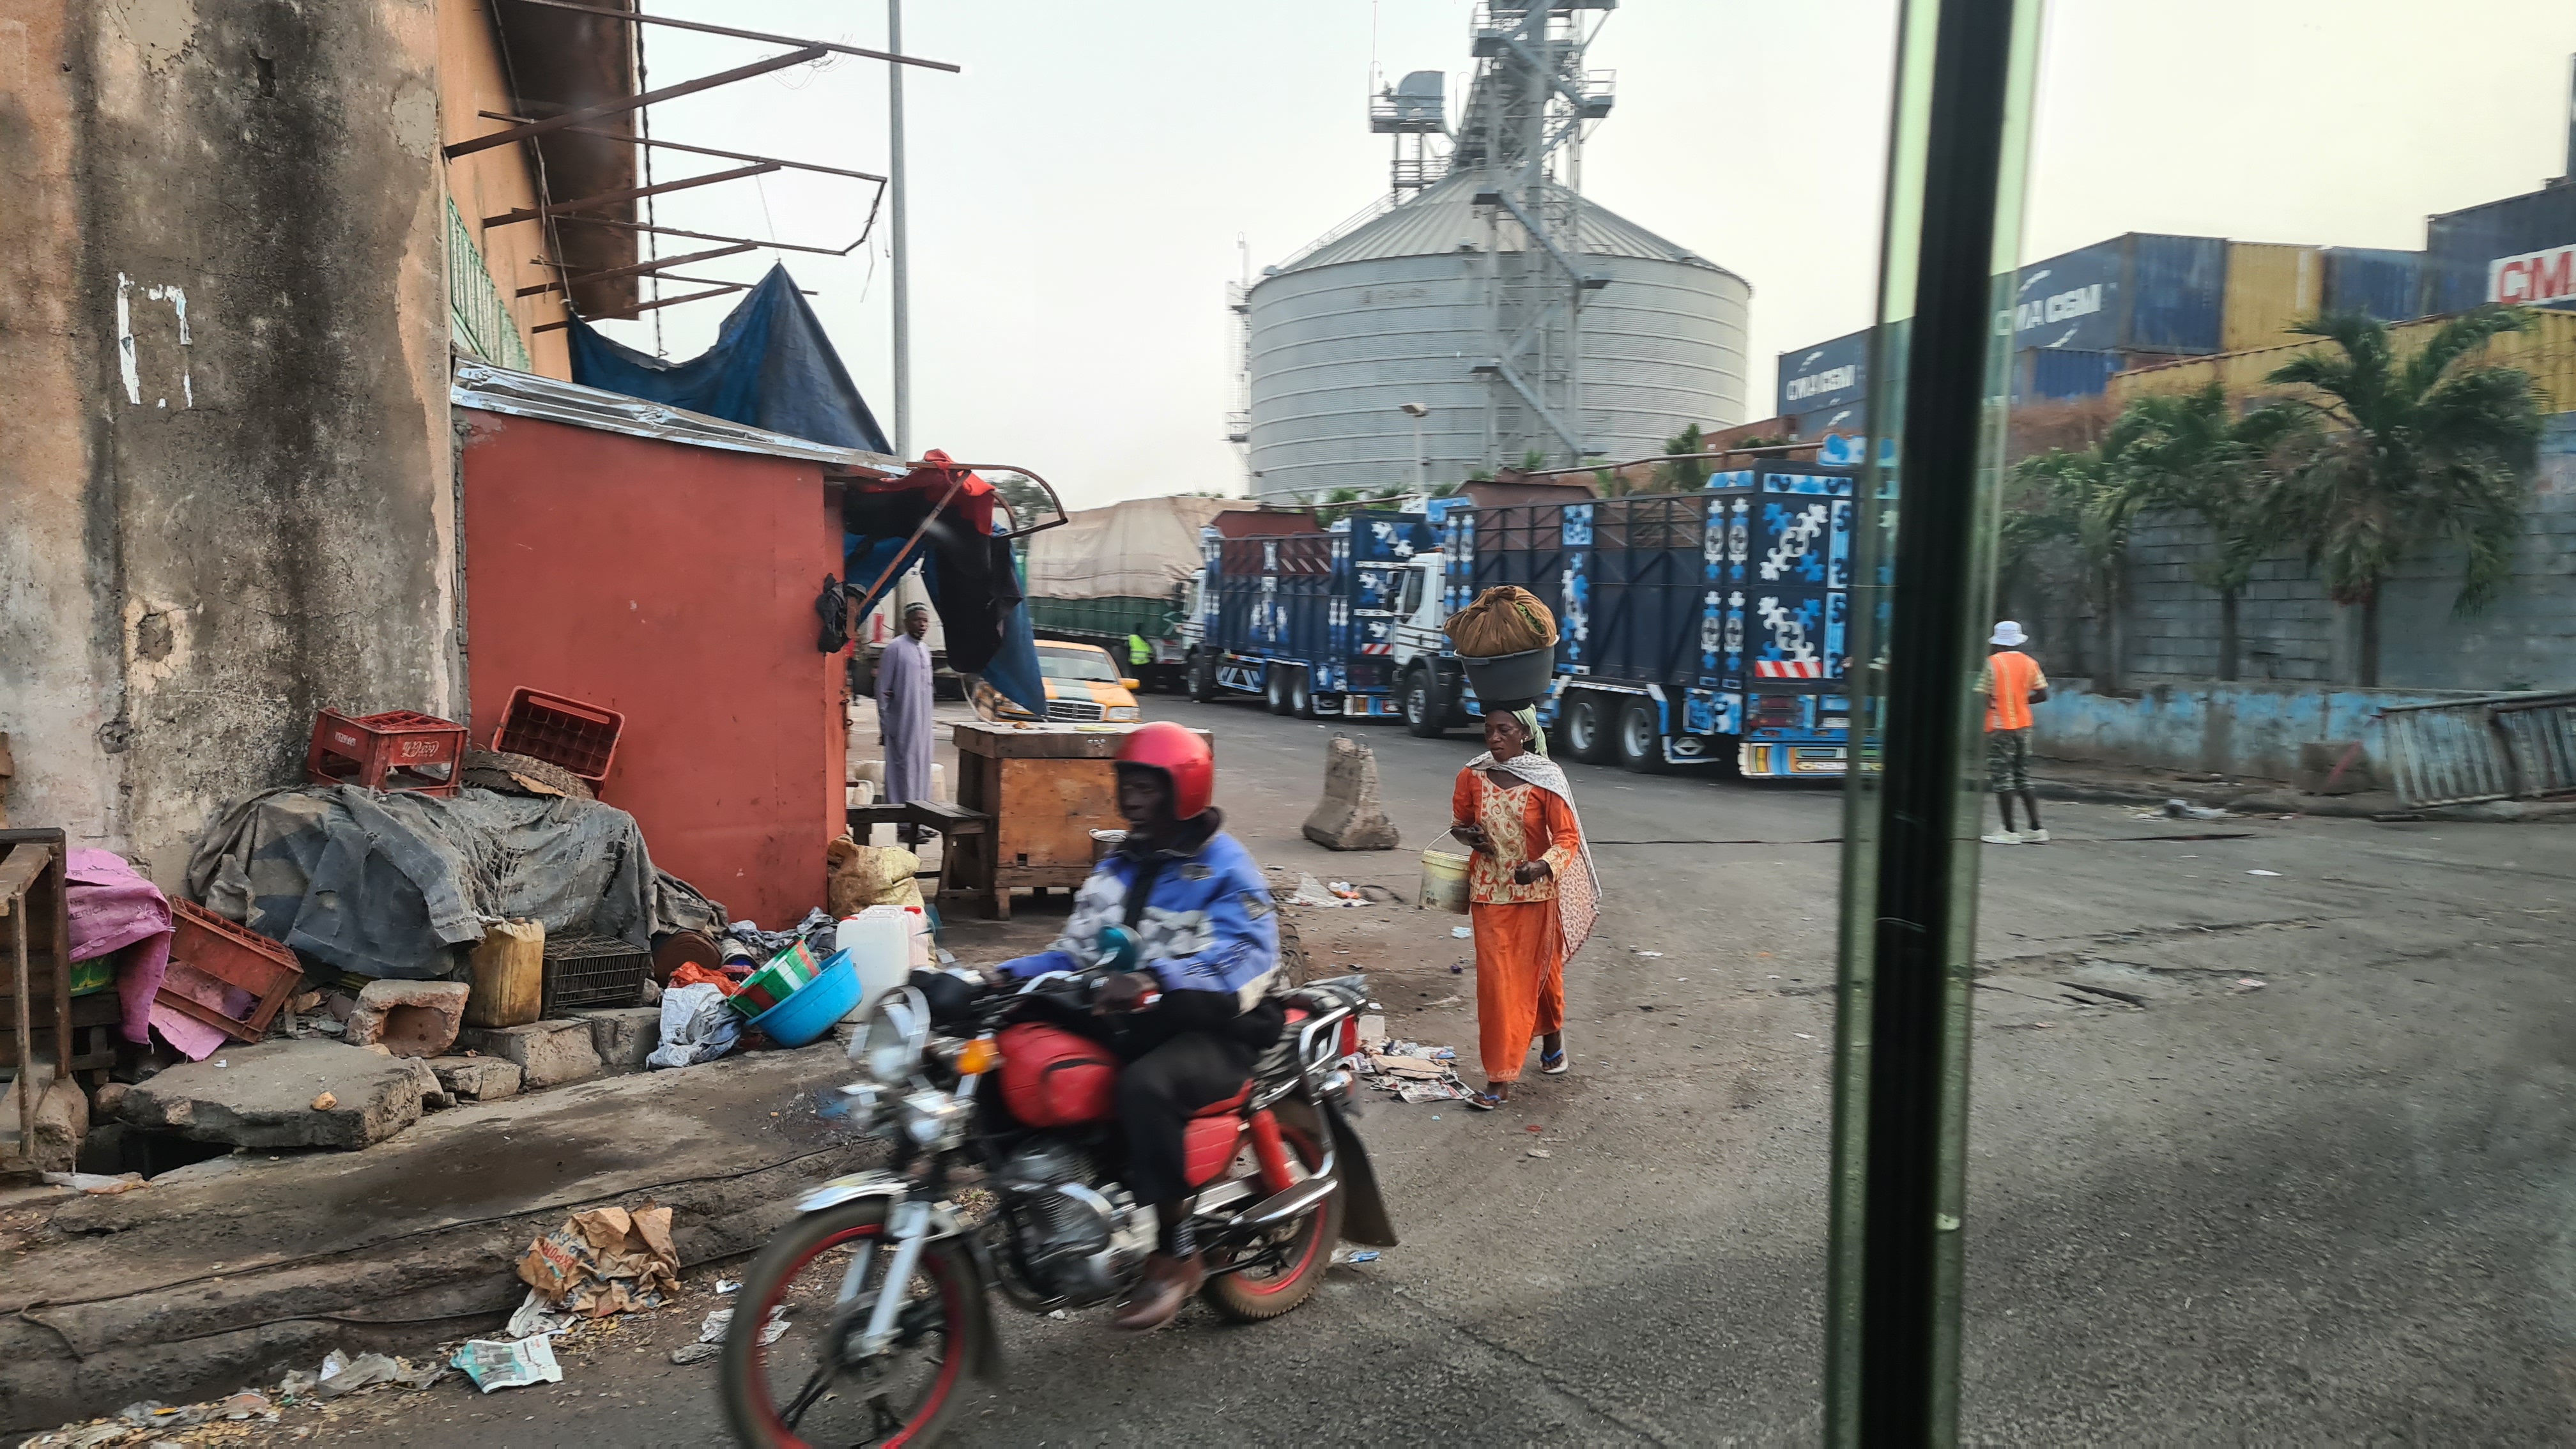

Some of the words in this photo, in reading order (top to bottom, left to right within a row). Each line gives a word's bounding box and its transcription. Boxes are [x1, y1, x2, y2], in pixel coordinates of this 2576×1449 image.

[2499, 251, 2576, 304] CM
[1995, 300, 2044, 336] CMA
[68, 905, 107, 921] MERICA
